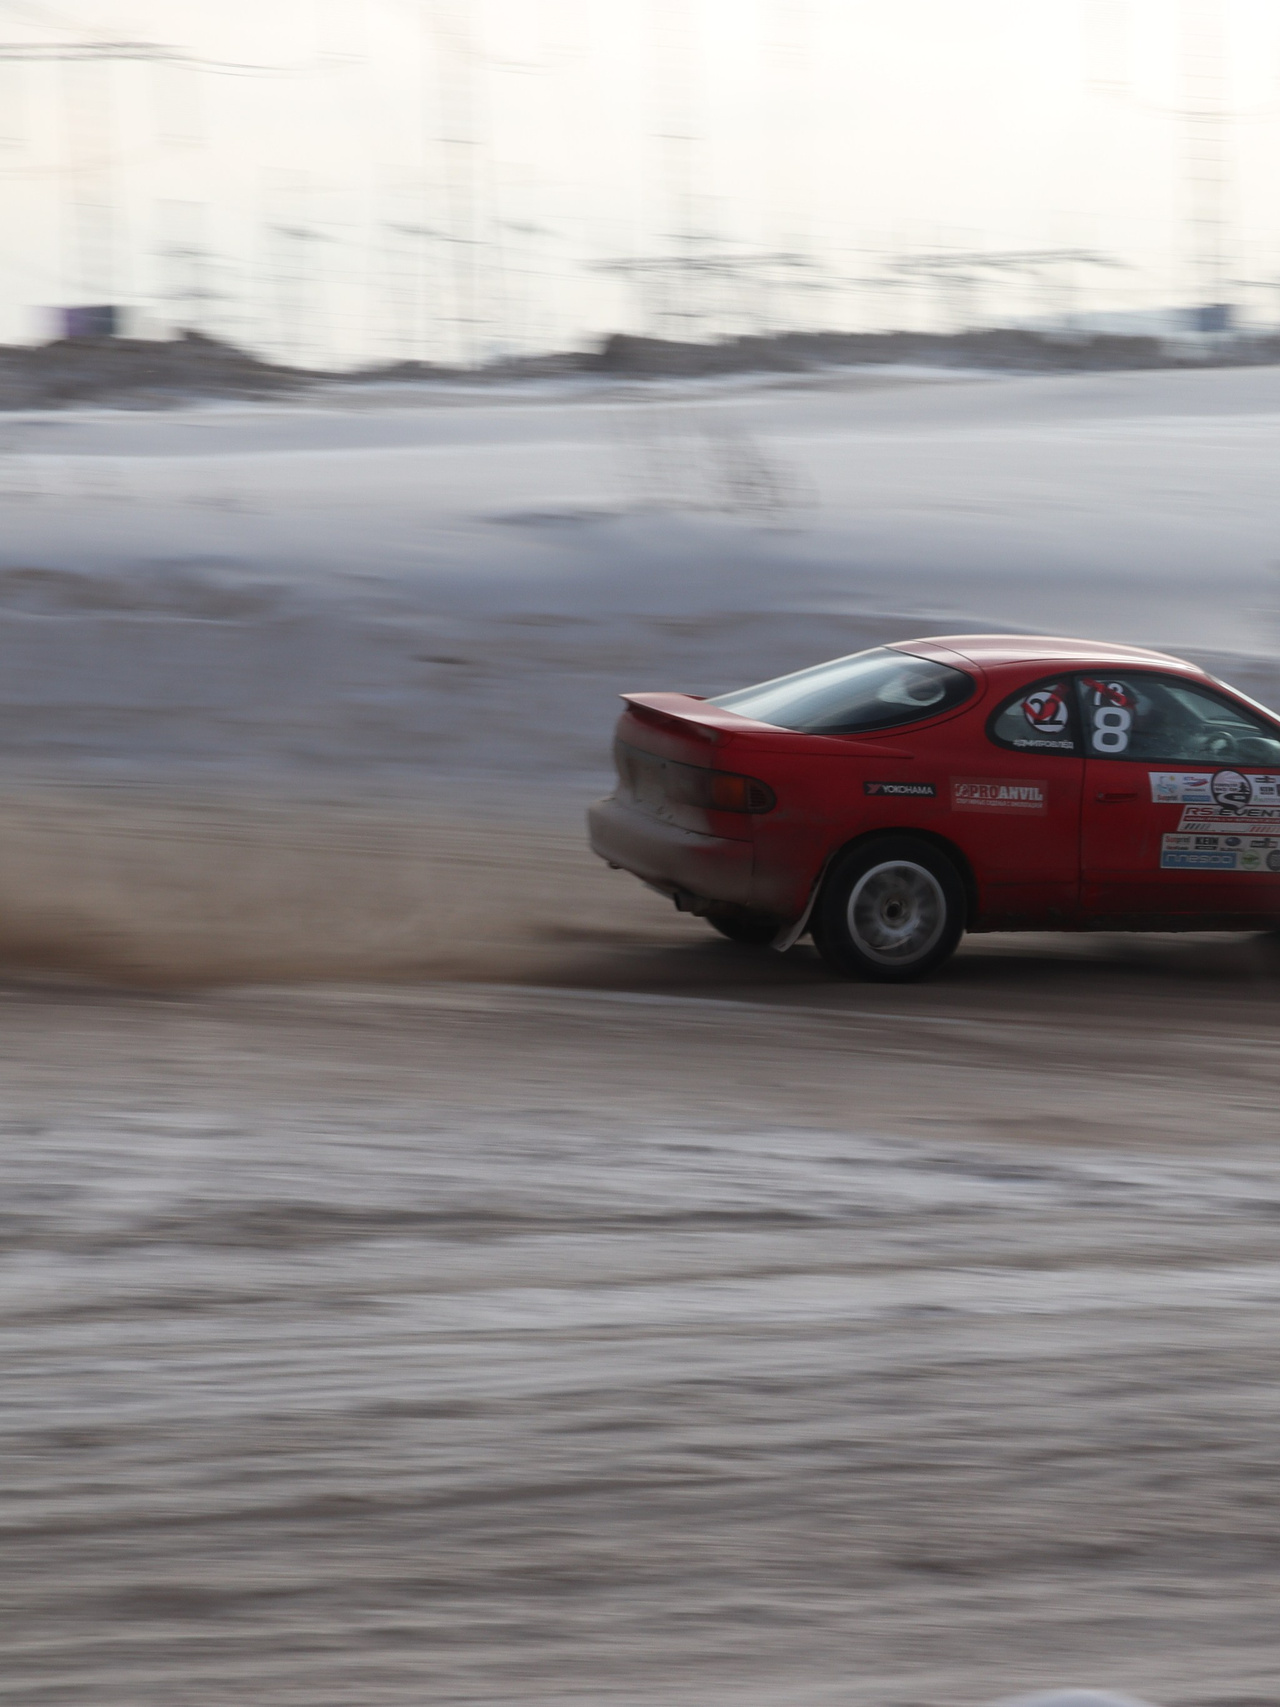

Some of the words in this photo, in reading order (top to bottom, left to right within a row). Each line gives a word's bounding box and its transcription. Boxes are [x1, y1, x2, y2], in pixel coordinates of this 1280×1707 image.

[1092, 706, 1131, 753] 8
[882, 784, 934, 795] YOKOHAMA
[969, 784, 1043, 801] PROANVIL
[1185, 807, 1213, 816] RS
